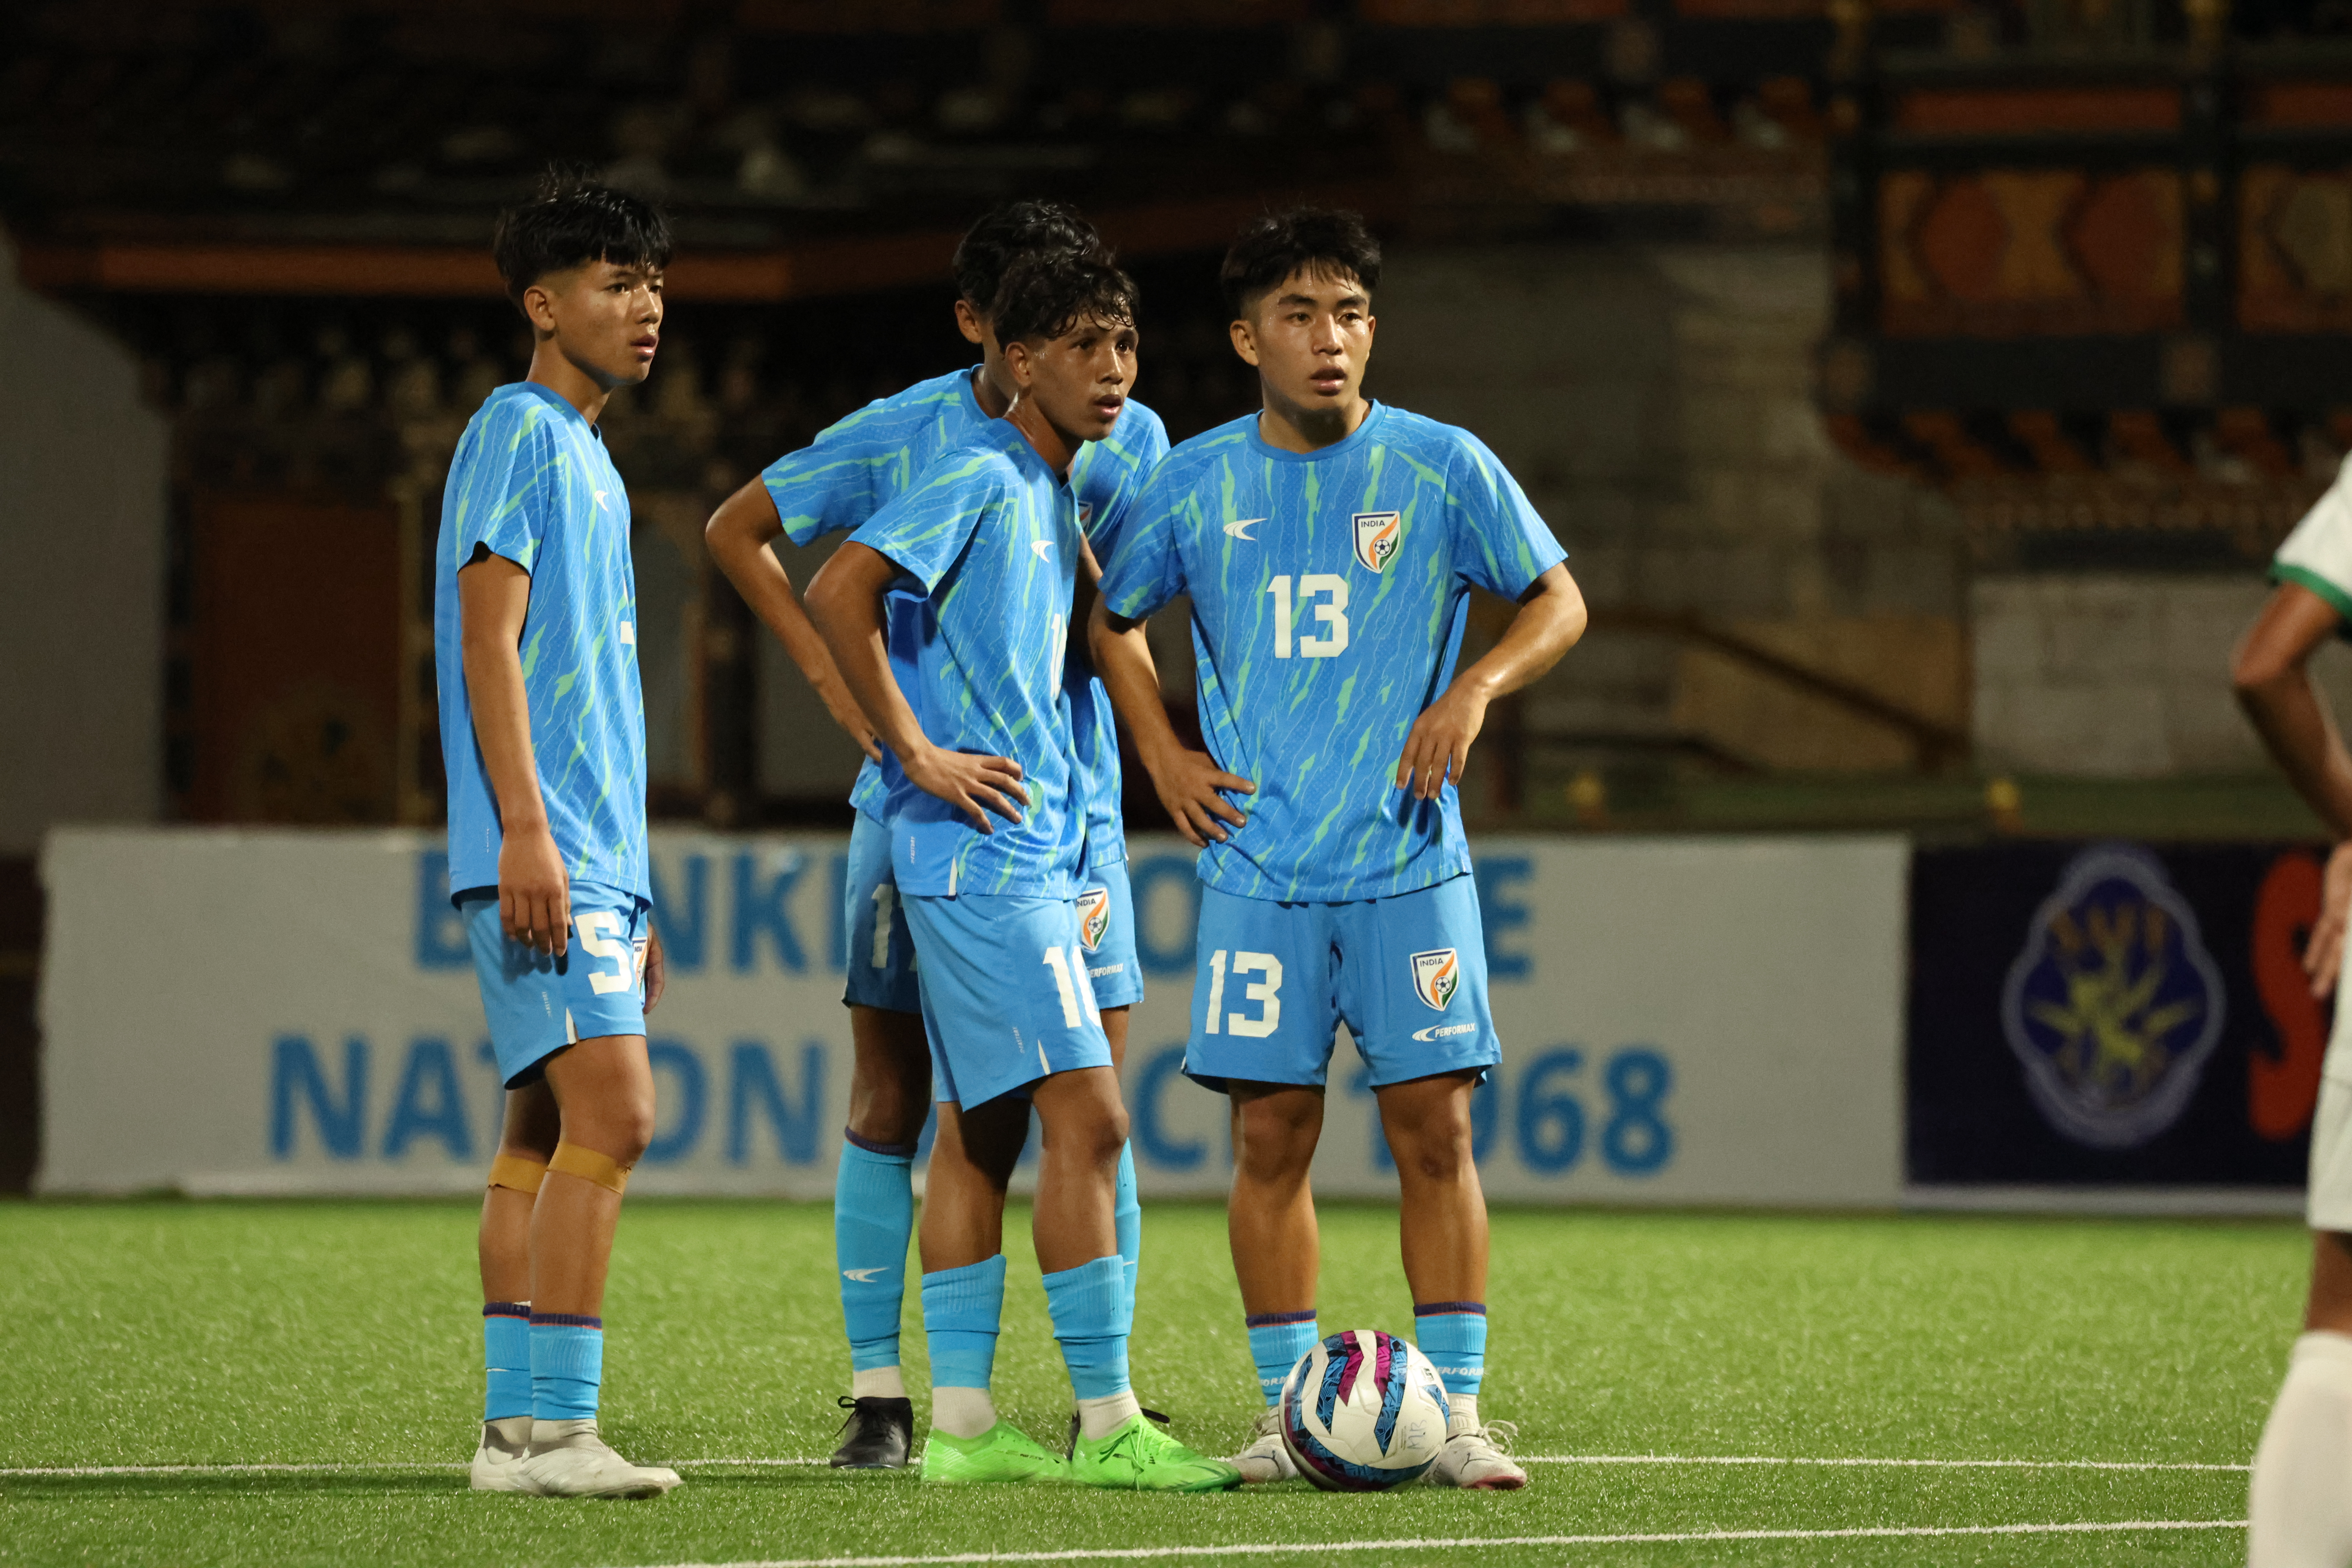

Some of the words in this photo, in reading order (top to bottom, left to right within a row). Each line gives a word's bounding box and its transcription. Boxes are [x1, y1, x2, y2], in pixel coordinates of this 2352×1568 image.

[1361, 519, 1385, 528] INDIA
[1267, 574, 1348, 659] 13
[575, 912, 632, 995] 5
[1205, 949, 1283, 1038] 13
[1419, 957, 1444, 967] INDIA
[1435, 1022, 1475, 1038] PERFORMAX
[270, 1033, 829, 1167] NAON
